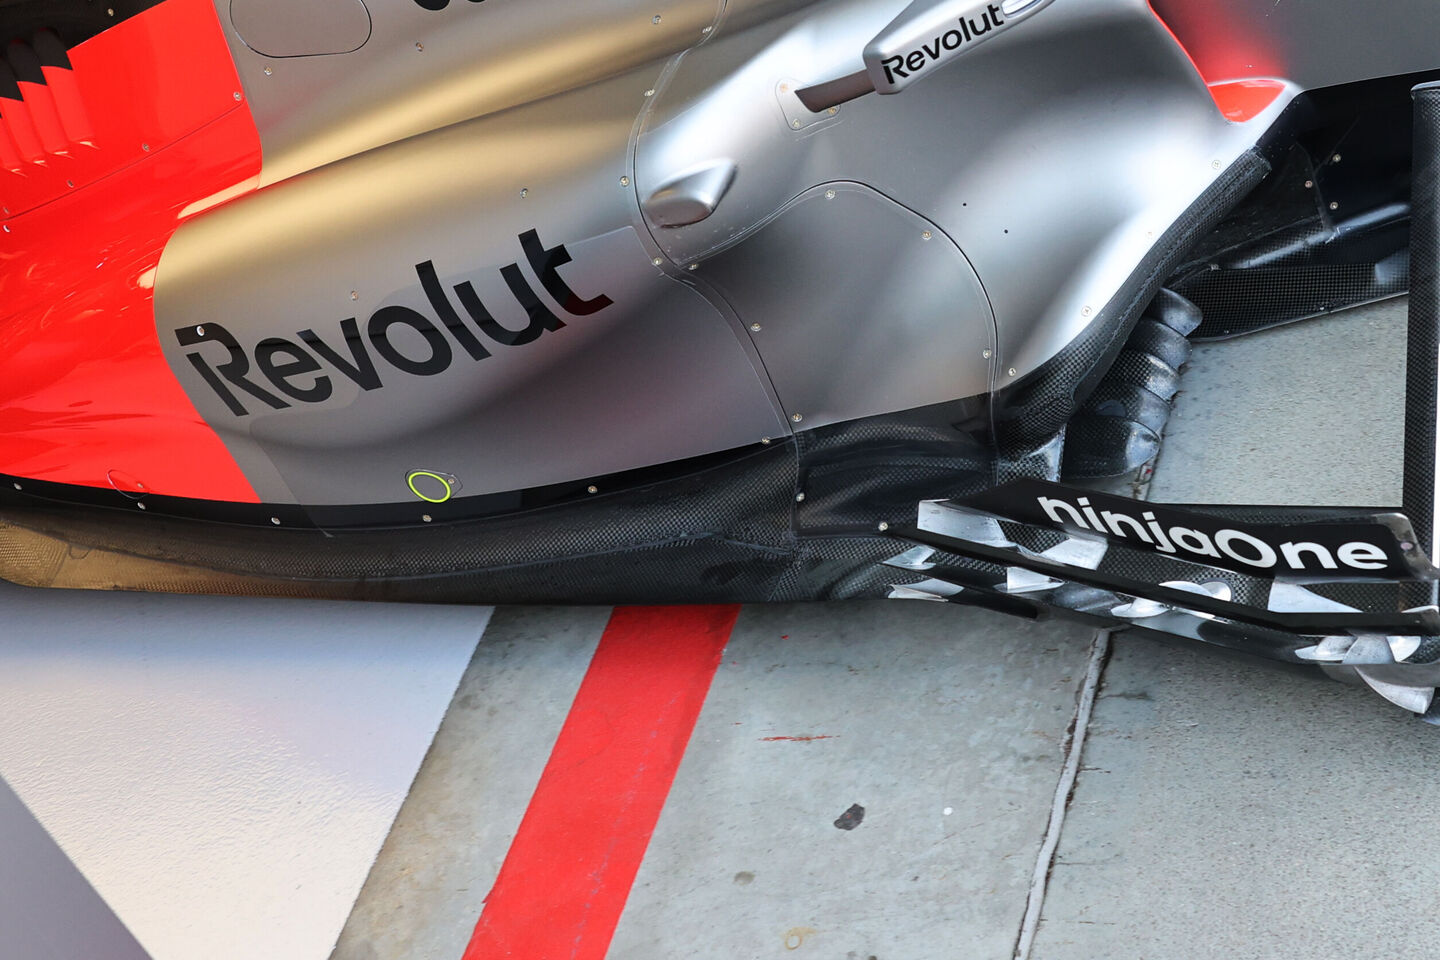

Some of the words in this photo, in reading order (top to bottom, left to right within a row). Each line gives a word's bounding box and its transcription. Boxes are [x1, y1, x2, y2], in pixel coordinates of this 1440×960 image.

[881, 4, 1006, 85] Revolut
[174, 228, 615, 418] Revolut
[1037, 494, 1390, 571] ninjaOne
